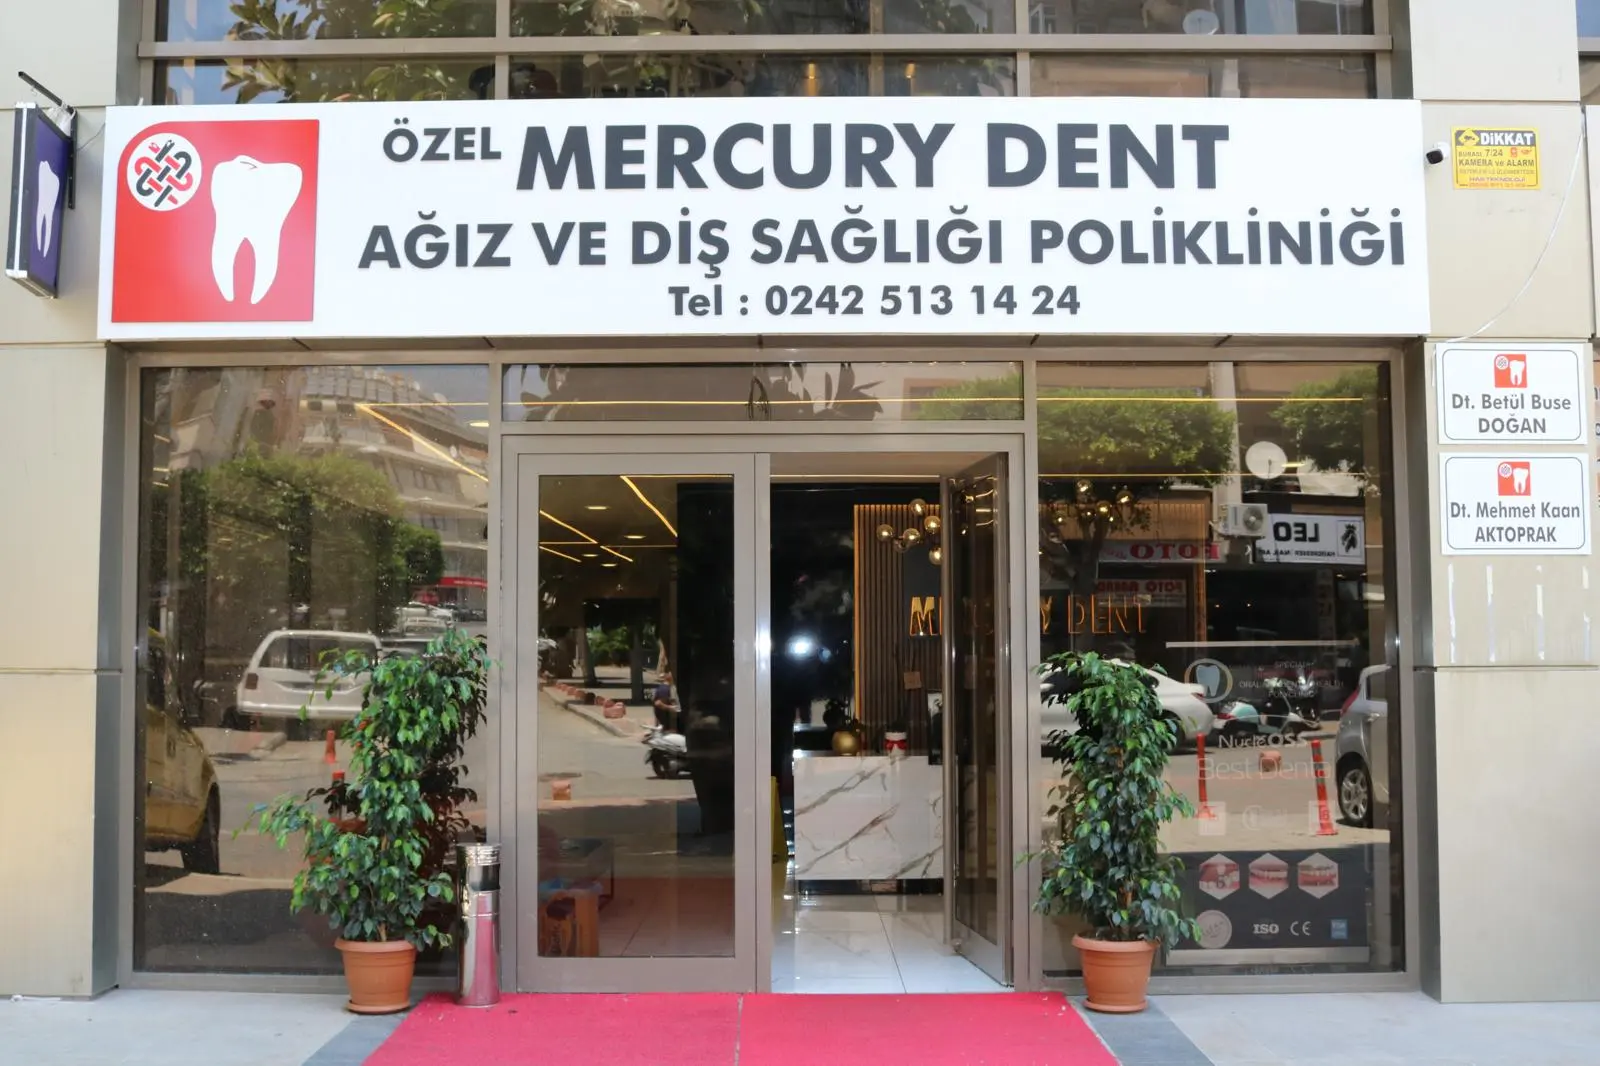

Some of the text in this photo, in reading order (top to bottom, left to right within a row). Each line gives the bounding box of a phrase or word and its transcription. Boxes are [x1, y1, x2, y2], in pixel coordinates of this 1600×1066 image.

[382, 117, 1230, 191] ÖZEL MERCURY DENT
[1458, 159, 1493, 167] KAMERA
[1506, 159, 1535, 167] ALARM
[358, 204, 1405, 279] AĞIZ VE DİŞ SAĞLIĞI POLİKLİNİĞİ
[668, 284, 1081, 316] Tel : 0242 513 14 24
[1451, 393, 1572, 410] Dt. Betül Buse
[1478, 413, 1546, 434] DOĞAN
[1450, 501, 1580, 519] Dt. Mehmet Kaan
[1475, 526, 1557, 543] AKTOPRAK
[1198, 757, 1250, 780] Best
[1252, 923, 1280, 935] ISO
